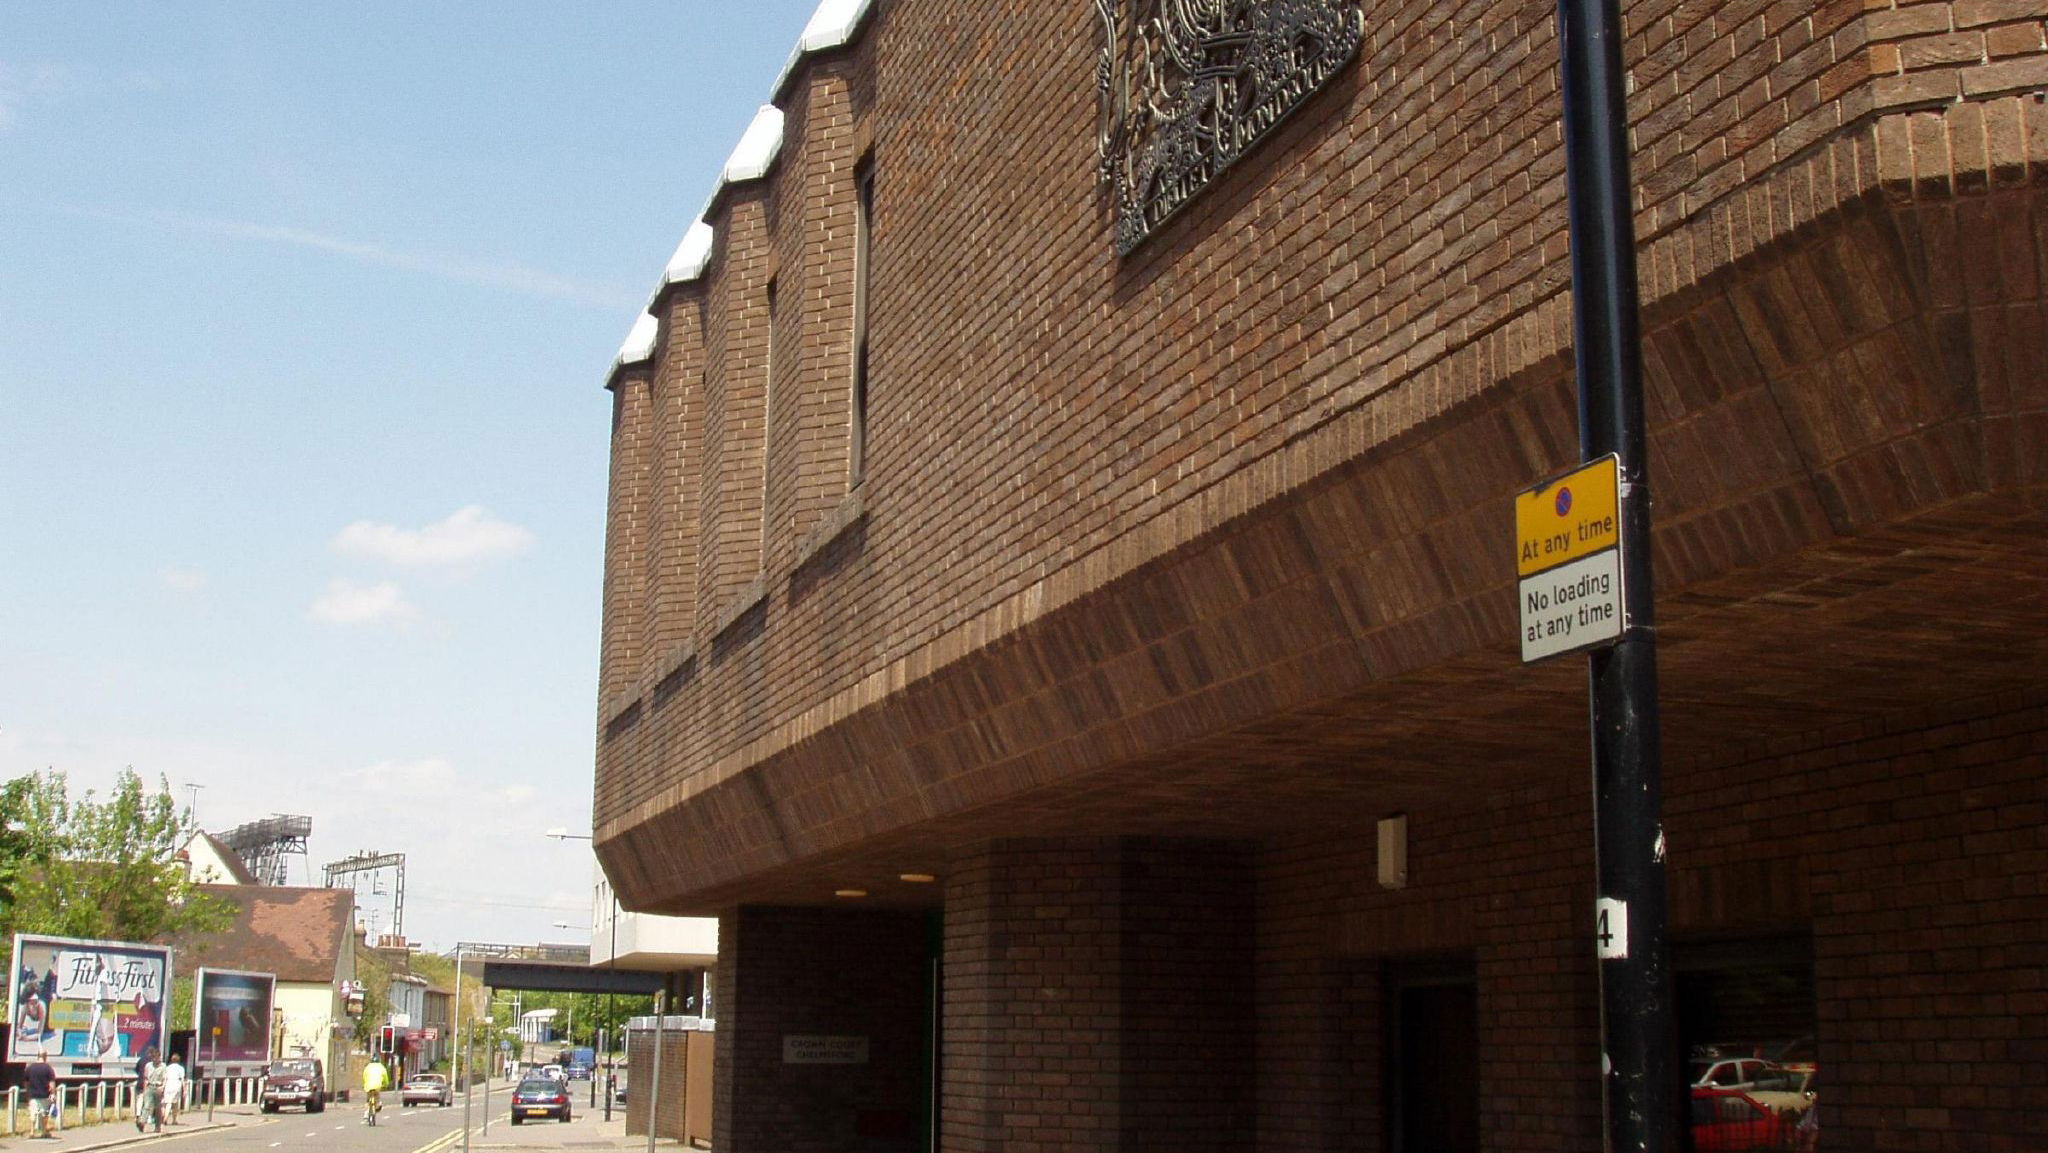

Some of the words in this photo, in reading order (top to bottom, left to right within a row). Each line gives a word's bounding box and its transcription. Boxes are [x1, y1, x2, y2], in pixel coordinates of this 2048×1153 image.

[1522, 539, 1538, 562] At
[1545, 532, 1570, 553] any
[1578, 516, 1612, 541] time
[1527, 591, 1549, 614] No
[1553, 573, 1610, 605] loading
[1527, 620, 1542, 642] at
[1546, 614, 1573, 636] any
[1578, 602, 1613, 627] time
[1598, 908, 1613, 948] 4
[120, 961, 156, 993] First
